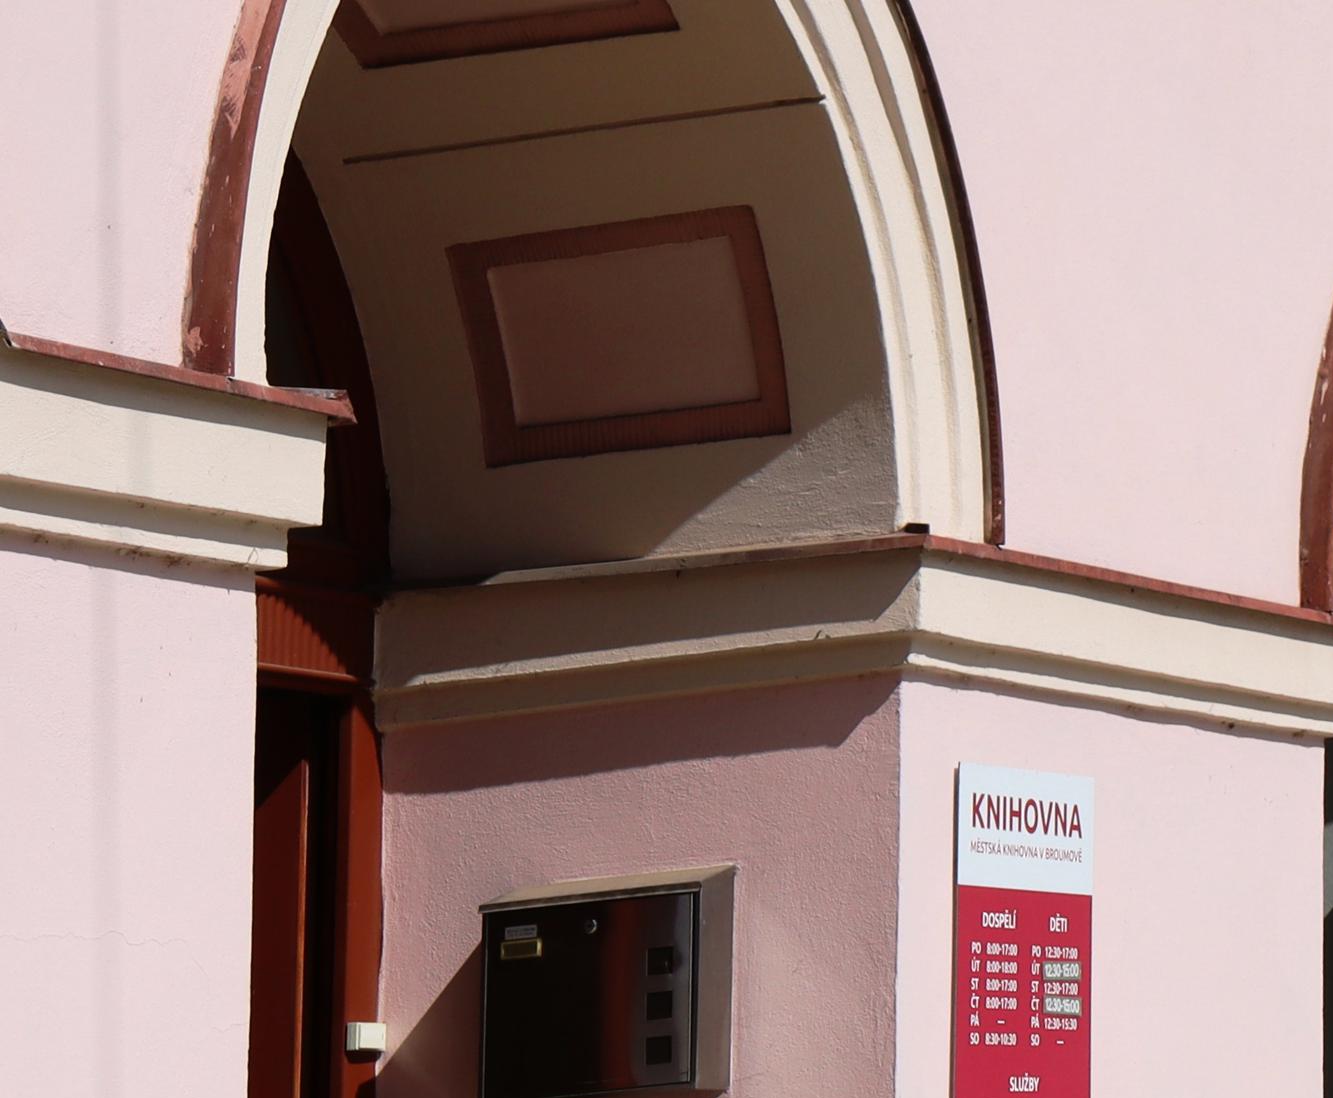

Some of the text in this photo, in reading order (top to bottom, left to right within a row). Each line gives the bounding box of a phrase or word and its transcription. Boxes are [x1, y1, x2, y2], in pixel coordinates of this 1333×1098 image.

[972, 793, 1083, 839] KNIHOVNA
[970, 839, 1001, 855] MĚSTSKÁ
[1003, 845, 1037, 860] KNIHOVNA
[1046, 849, 1082, 863] BROUMOVĚ
[982, 909, 1017, 929] DOSPĚLÍ
[1050, 913, 1068, 932] DĚTI
[971, 942, 982, 954] PO
[1031, 945, 1041, 958] PO
[971, 957, 981, 972] ÚT
[1031, 960, 1041, 975] ÚT
[970, 978, 980, 990] ST
[1031, 981, 1040, 993] ST
[970, 995, 980, 1008] ČT
[1031, 997, 1040, 1010] ČT
[970, 1012, 980, 1026] PÁ
[1031, 1013, 1040, 1028] PÁ
[970, 1032, 980, 1045] SO
[1031, 1034, 1040, 1047] SO
[1009, 1073, 1040, 1092] SLUŽBY
